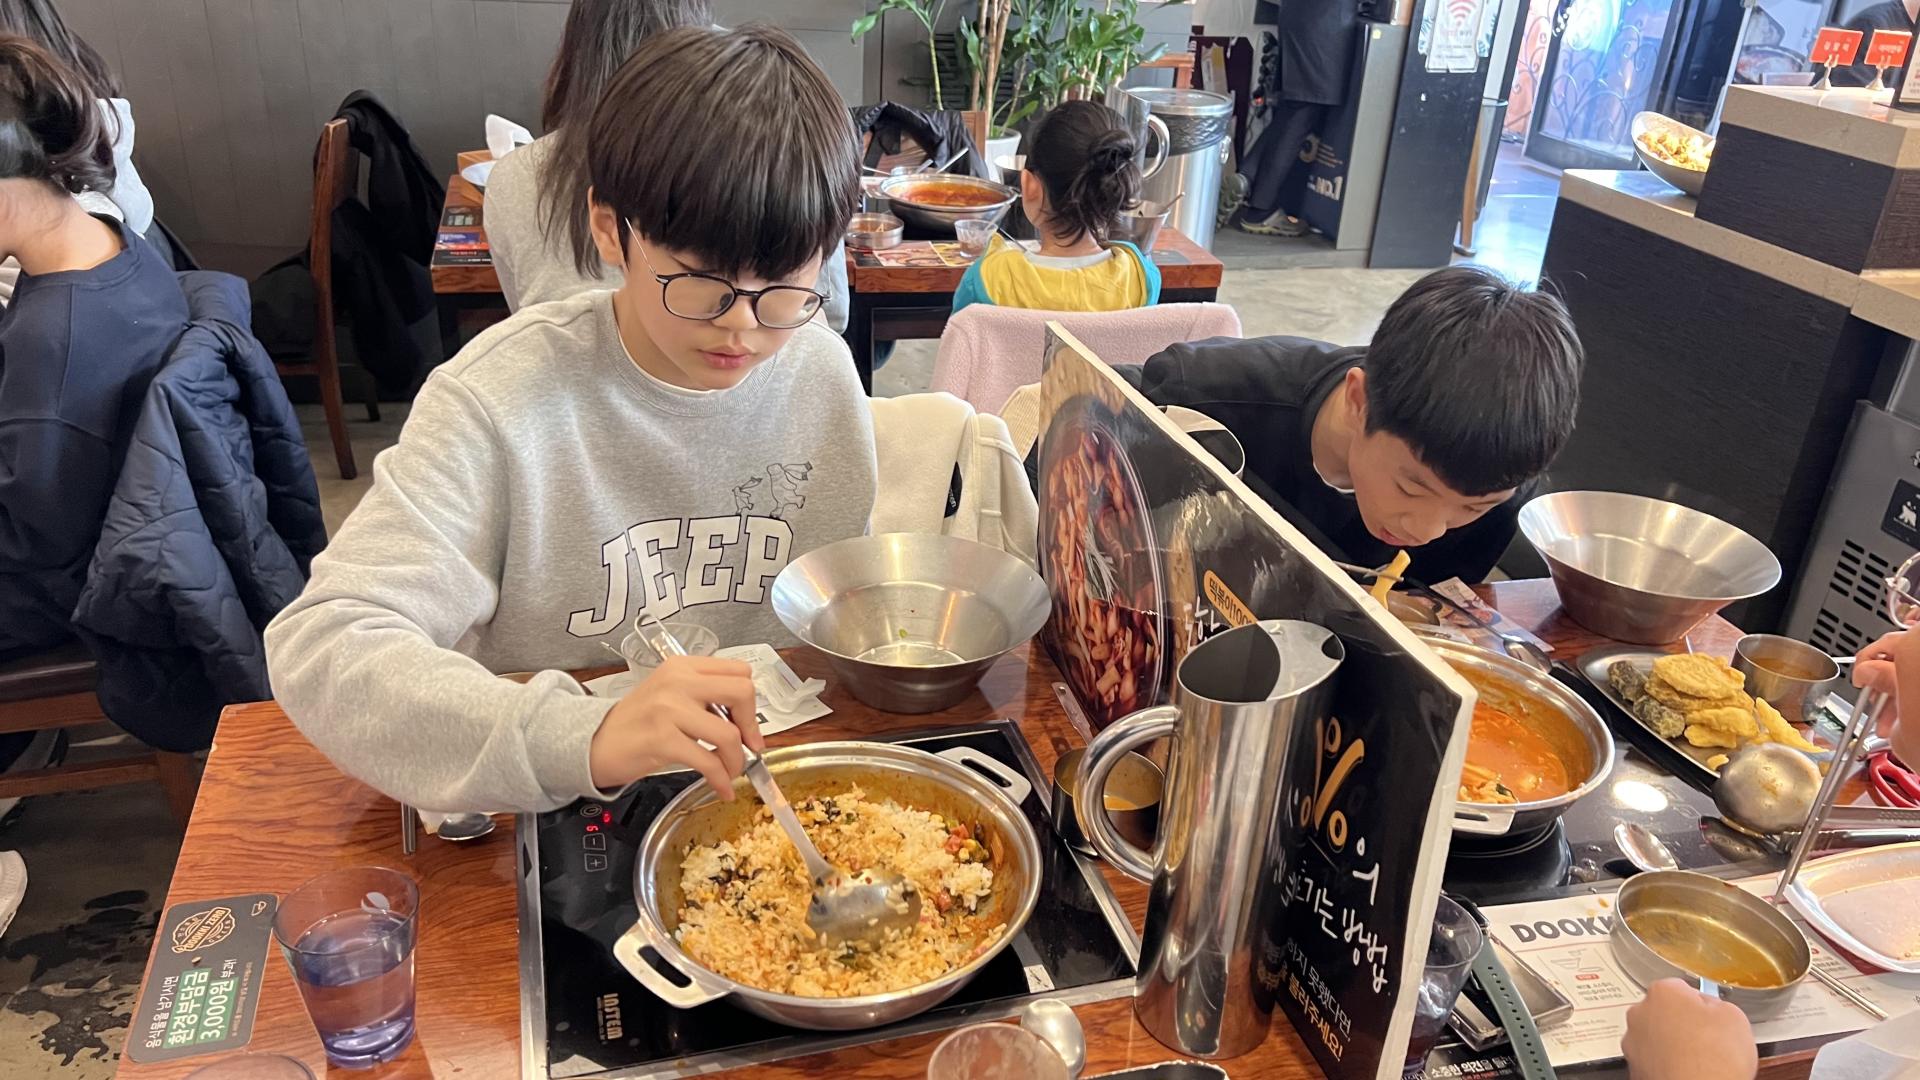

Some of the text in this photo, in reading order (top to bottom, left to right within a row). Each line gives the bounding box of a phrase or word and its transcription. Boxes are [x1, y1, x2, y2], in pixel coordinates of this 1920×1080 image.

[566, 515, 794, 638] JEEP
[1209, 577, 1253, 626] 떡볶이100
[145, 975, 180, 1048] 음식물을 남기시면
[167, 971, 209, 1045] 환경부담금
[200, 979, 235, 1041] 3,000원
